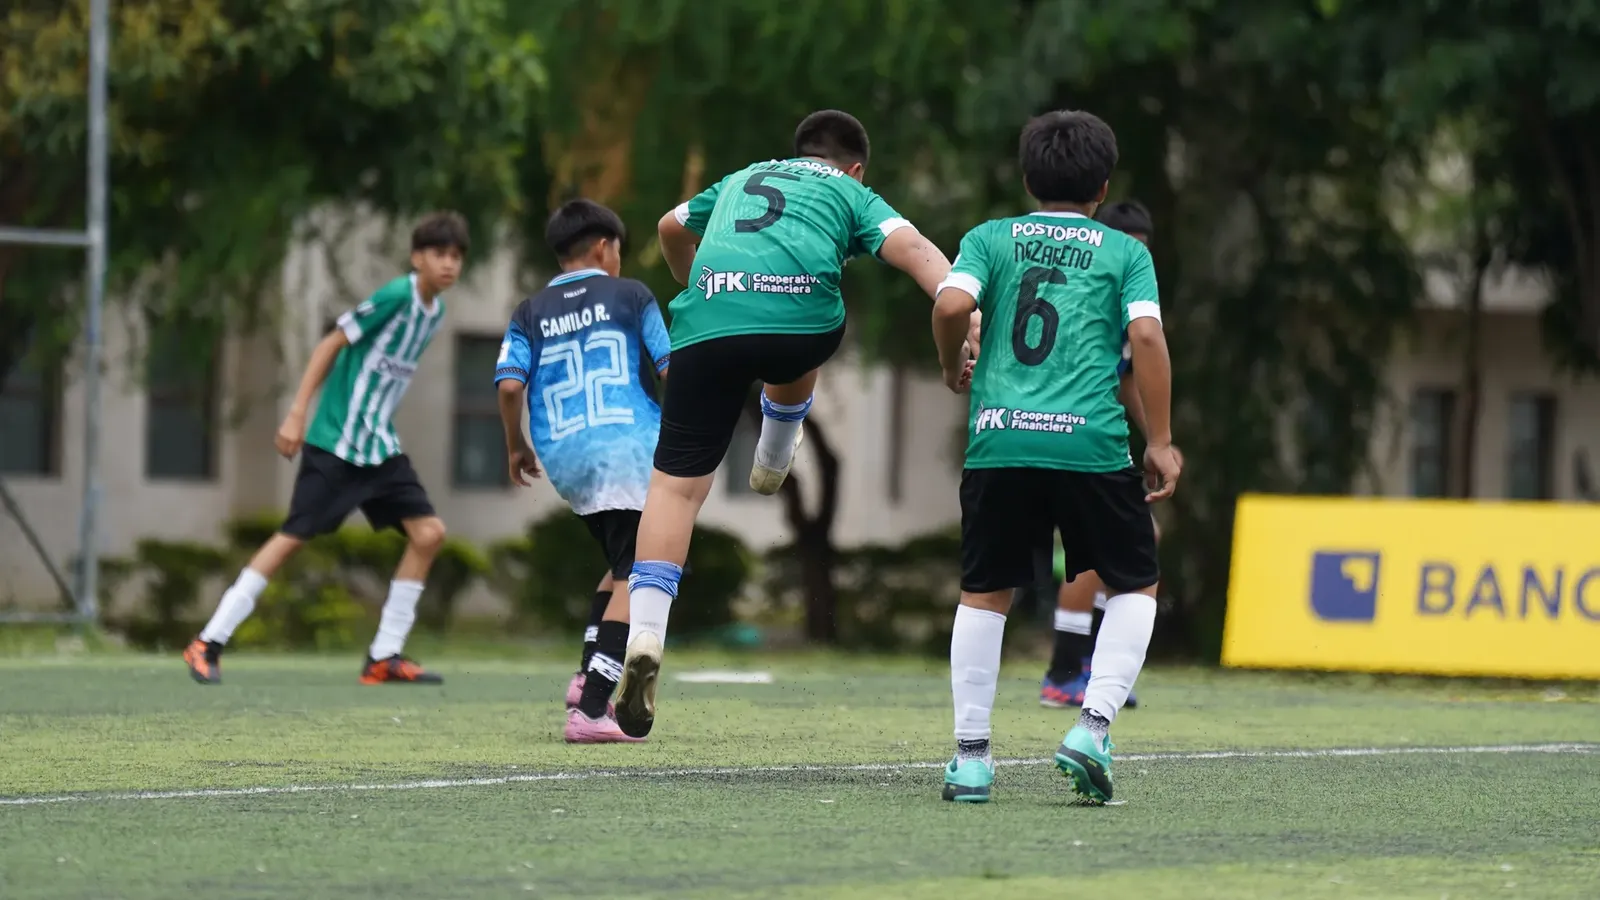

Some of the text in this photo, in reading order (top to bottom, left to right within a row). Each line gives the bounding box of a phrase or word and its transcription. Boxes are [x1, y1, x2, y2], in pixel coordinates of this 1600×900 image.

[735, 171, 801, 233] 5
[1012, 222, 1104, 247] POSTOBON
[704, 271, 747, 300] JFK
[752, 273, 821, 285] Cooperativ
[753, 282, 812, 294] Financiera
[540, 303, 611, 338] CAMILO R.
[1012, 266, 1068, 367] 6
[539, 330, 635, 441] 22
[1011, 419, 1073, 433] Financiera
[1012, 409, 1086, 425] Cooperativa
